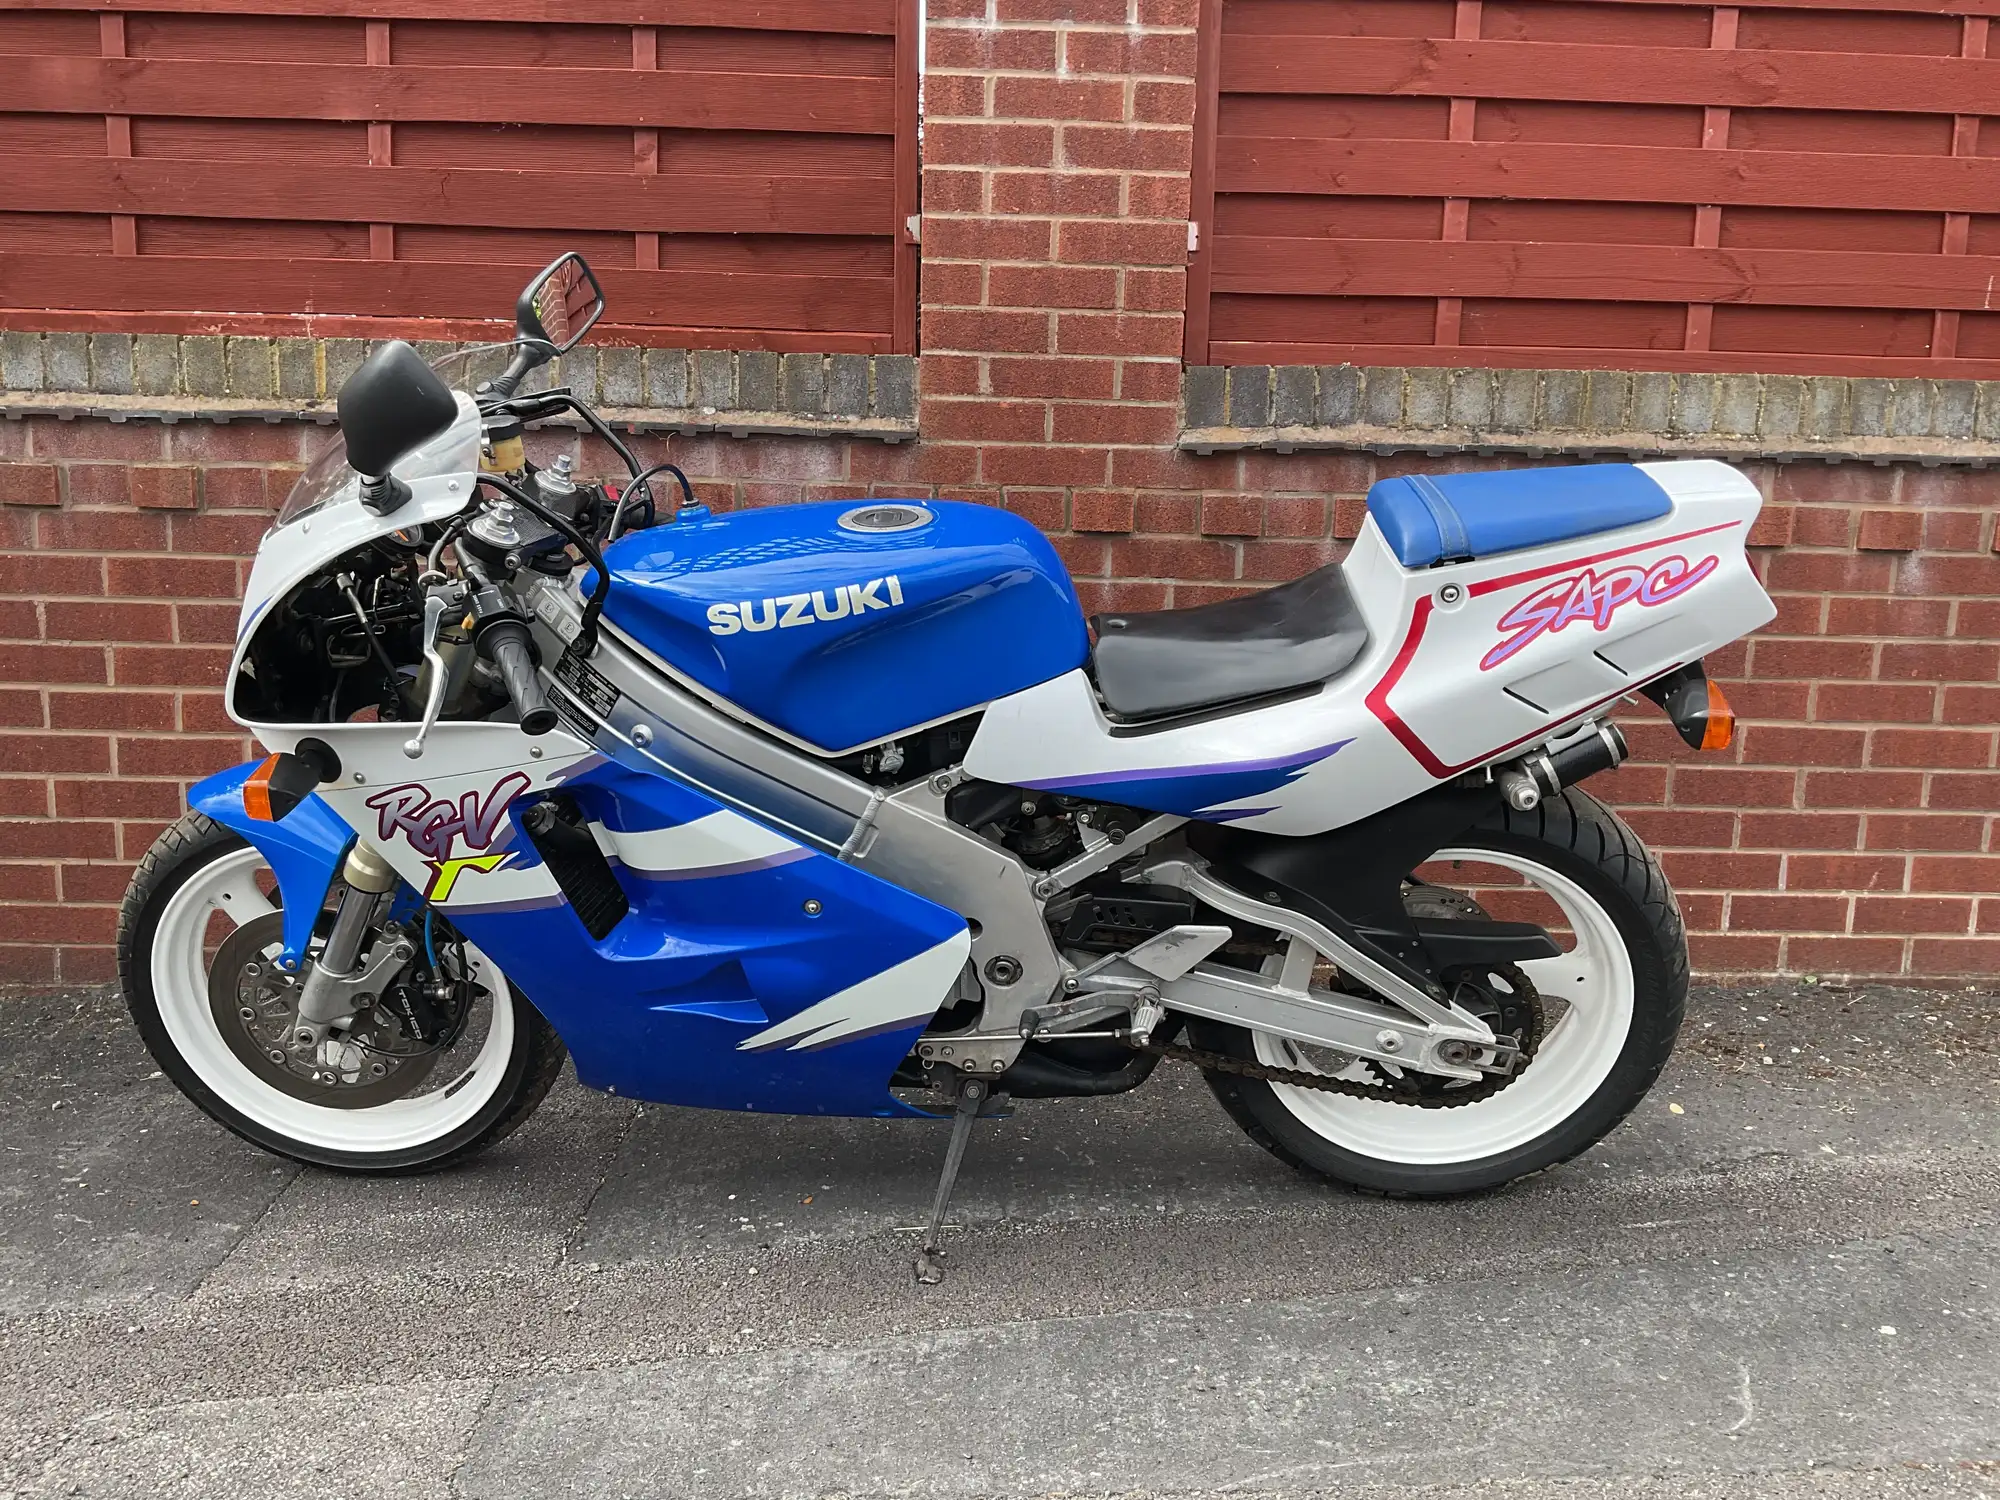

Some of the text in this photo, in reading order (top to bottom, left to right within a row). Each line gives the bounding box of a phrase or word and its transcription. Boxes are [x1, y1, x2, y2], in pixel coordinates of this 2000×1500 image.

[707, 575, 904, 636] SUZUKI
[1479, 555, 1719, 671] SAPC
[365, 771, 532, 865] RGV
[398, 988, 423, 1040] TOKICO
